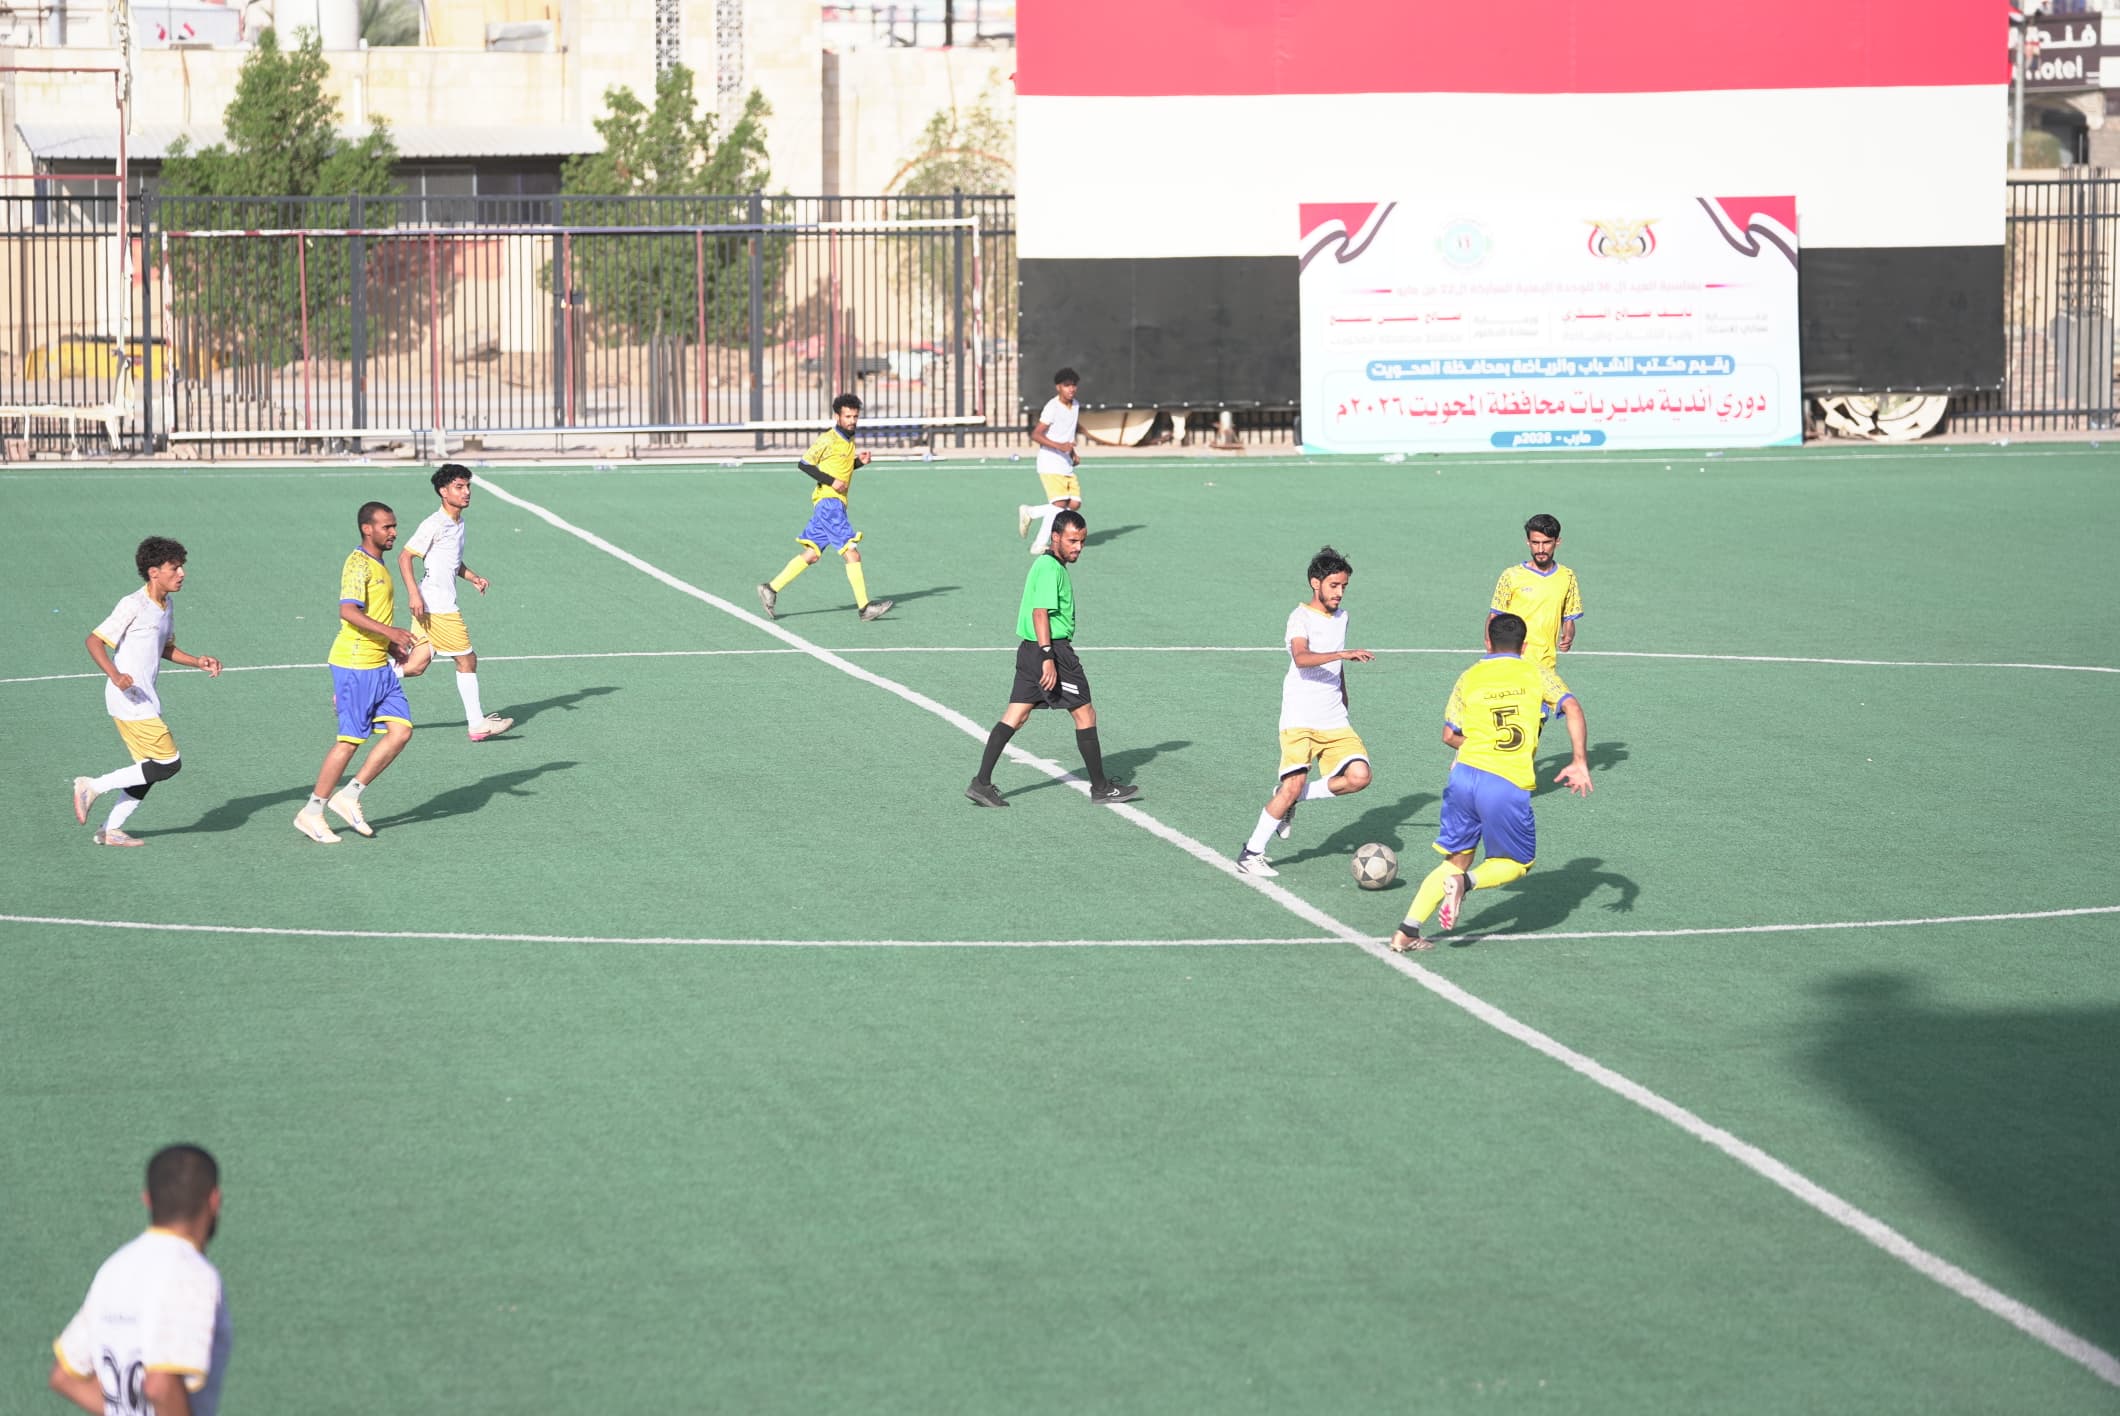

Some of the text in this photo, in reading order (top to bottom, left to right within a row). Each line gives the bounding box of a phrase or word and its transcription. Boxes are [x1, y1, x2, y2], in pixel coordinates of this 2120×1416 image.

[1578, 356, 1634, 376] الشباب
[1636, 356, 1687, 374] مكتب
[1409, 394, 1484, 424] المحويت
[1487, 390, 1565, 415] محافظة
[1569, 390, 1655, 422] مديريات
[1716, 392, 1766, 422] دوري
[1489, 705, 1526, 752] 5
